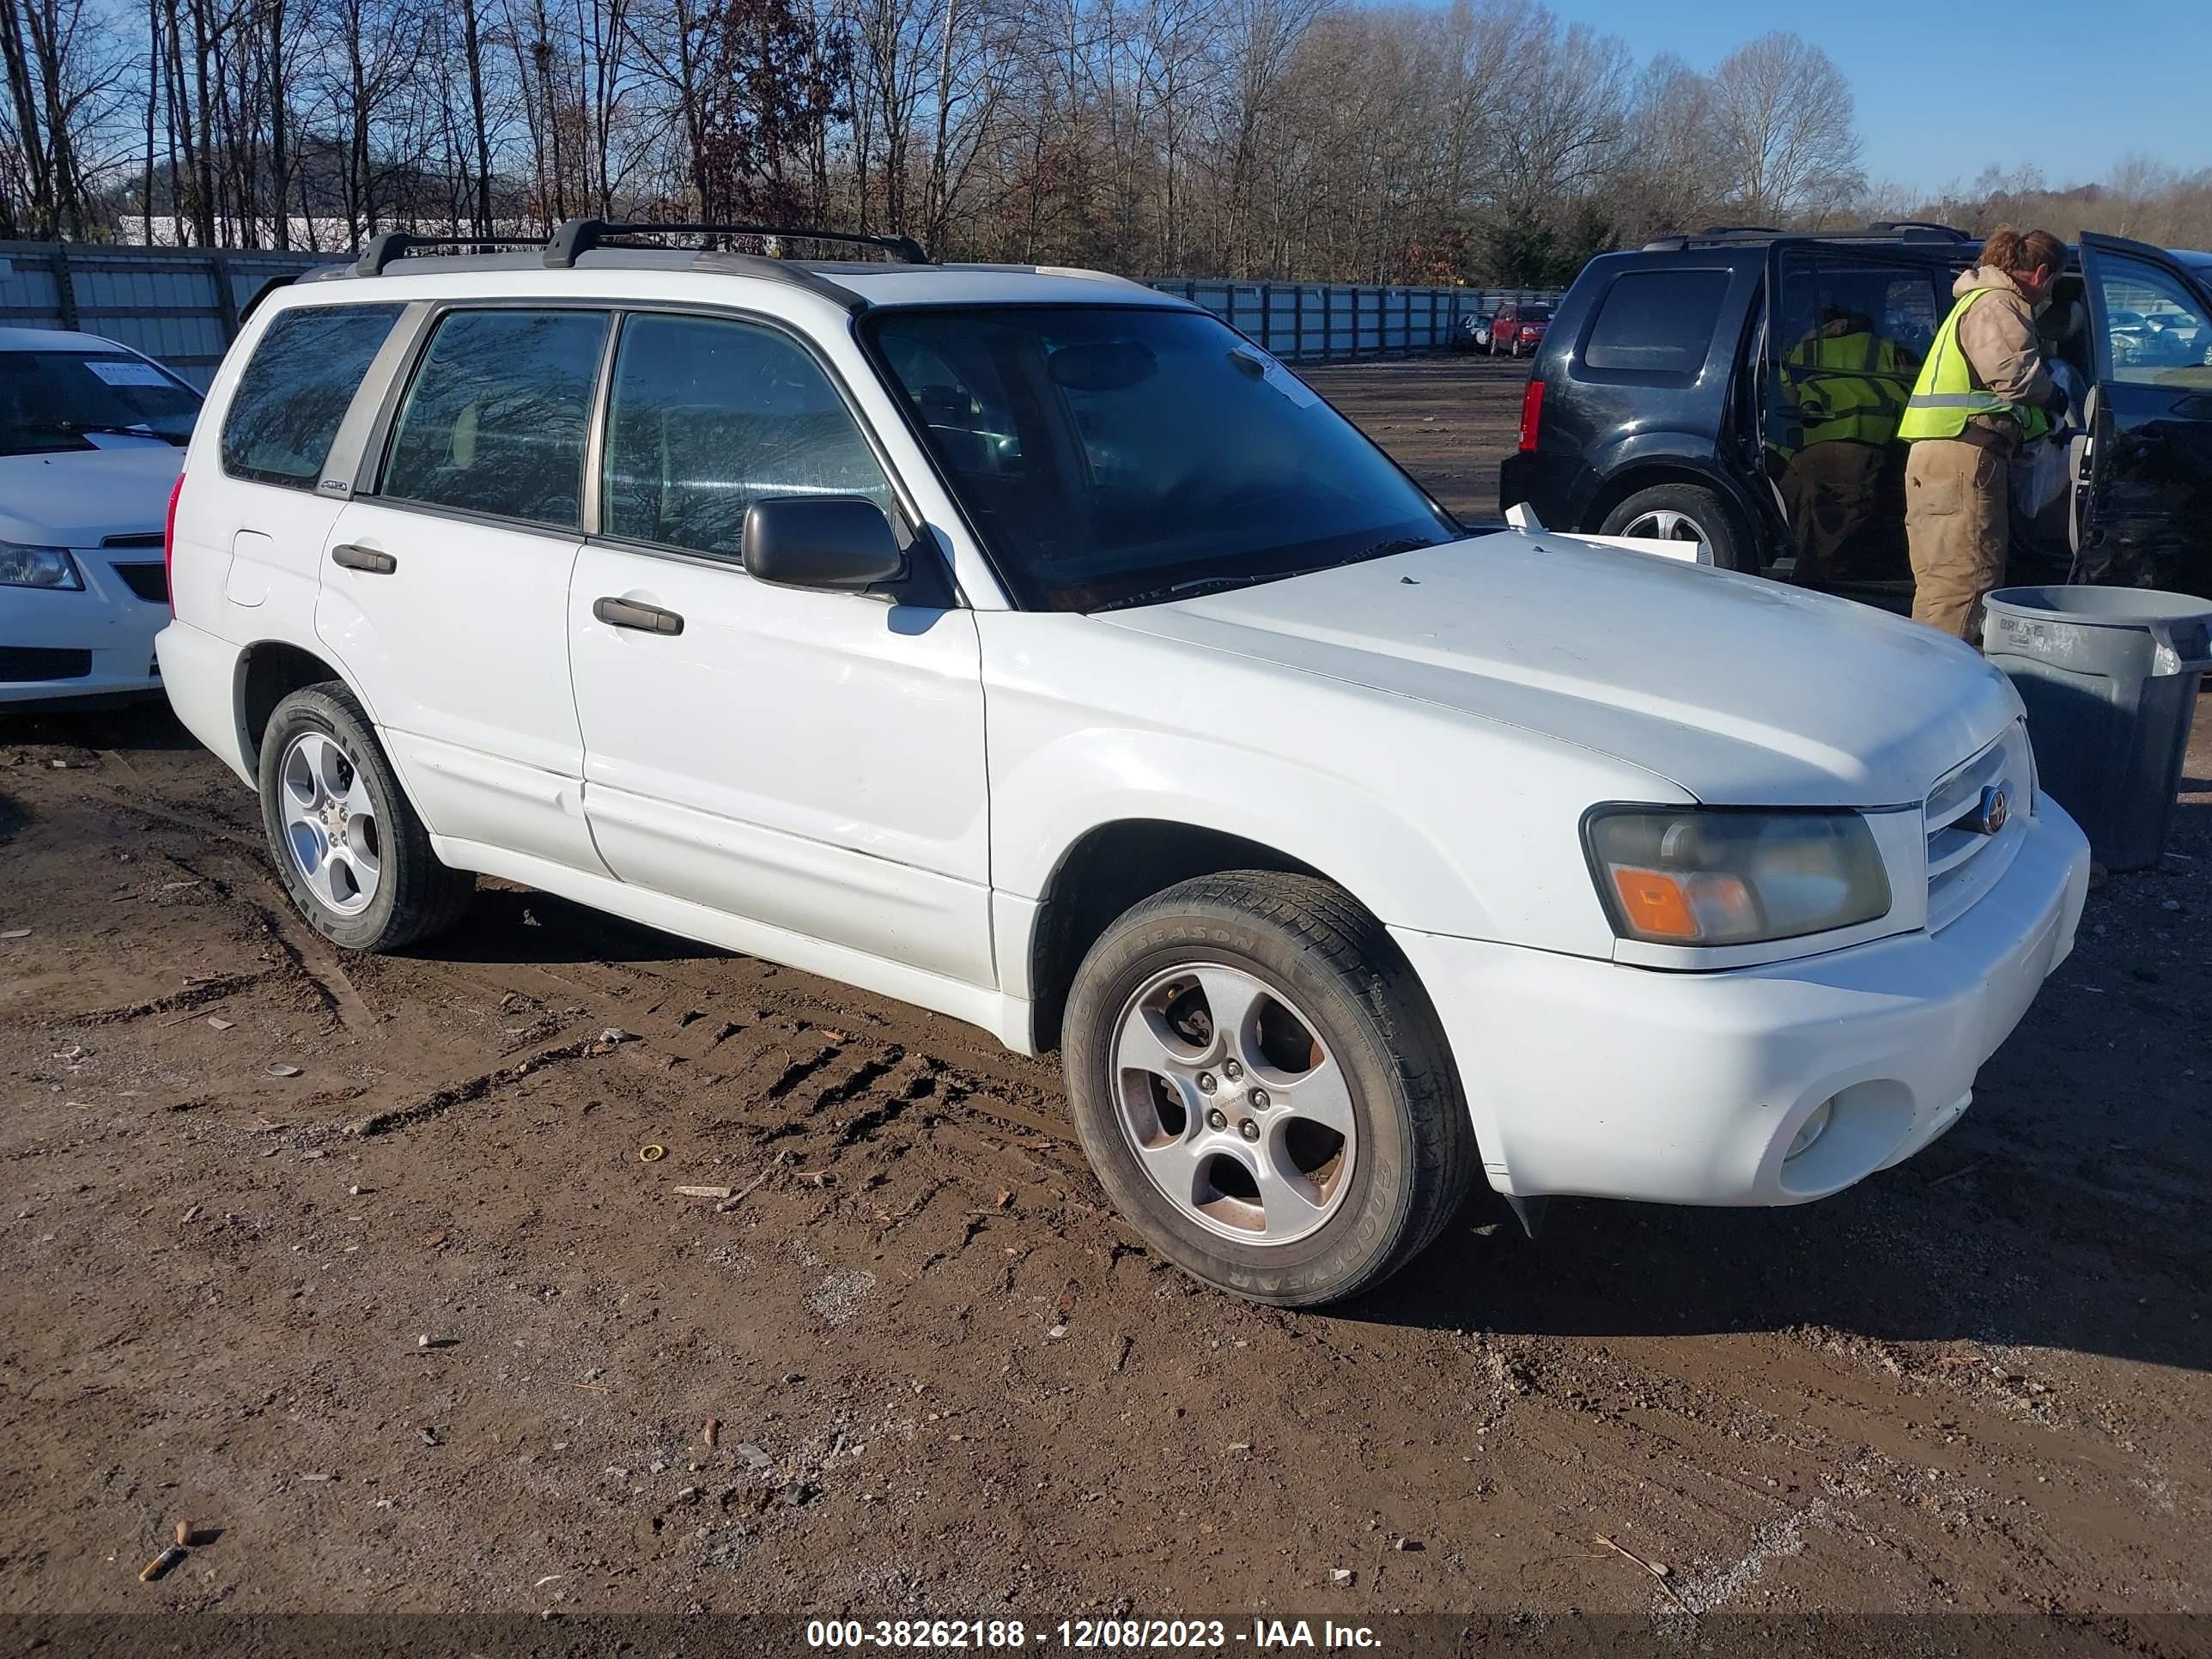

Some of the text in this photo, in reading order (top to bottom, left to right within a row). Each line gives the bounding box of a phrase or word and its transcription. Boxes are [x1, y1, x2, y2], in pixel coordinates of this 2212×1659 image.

[2000, 618, 2045, 637] BRUTE
[1073, 1030, 1087, 1109] VIVA
[1095, 926, 1257, 996] ALL-SEASON
[1229, 1159, 1393, 1291] GOODYEAR
